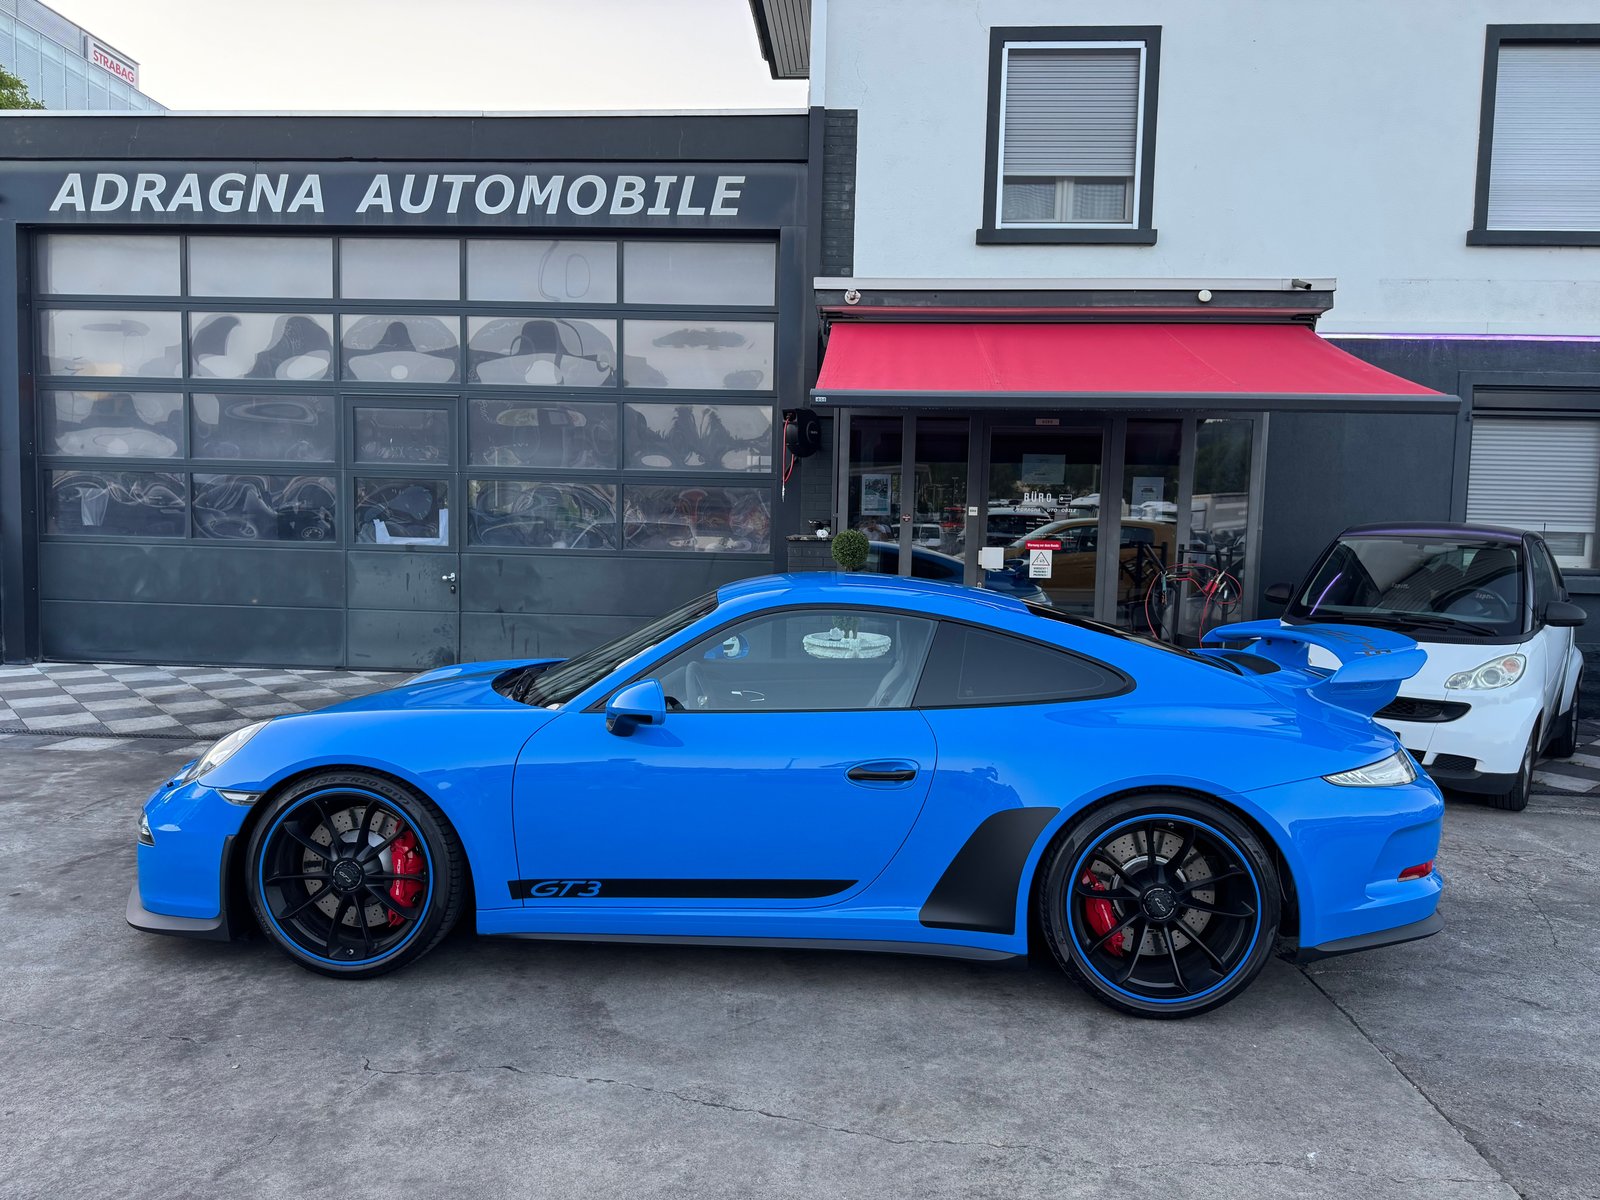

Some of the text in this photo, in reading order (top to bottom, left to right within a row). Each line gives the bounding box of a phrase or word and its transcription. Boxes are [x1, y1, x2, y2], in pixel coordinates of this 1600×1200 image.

[93, 49, 135, 83] STRABAG
[49, 173, 746, 216] ADRAGNA AUTOMOBILE
[1024, 490, 1052, 503] BÜRO
[530, 880, 601, 897] GT3
